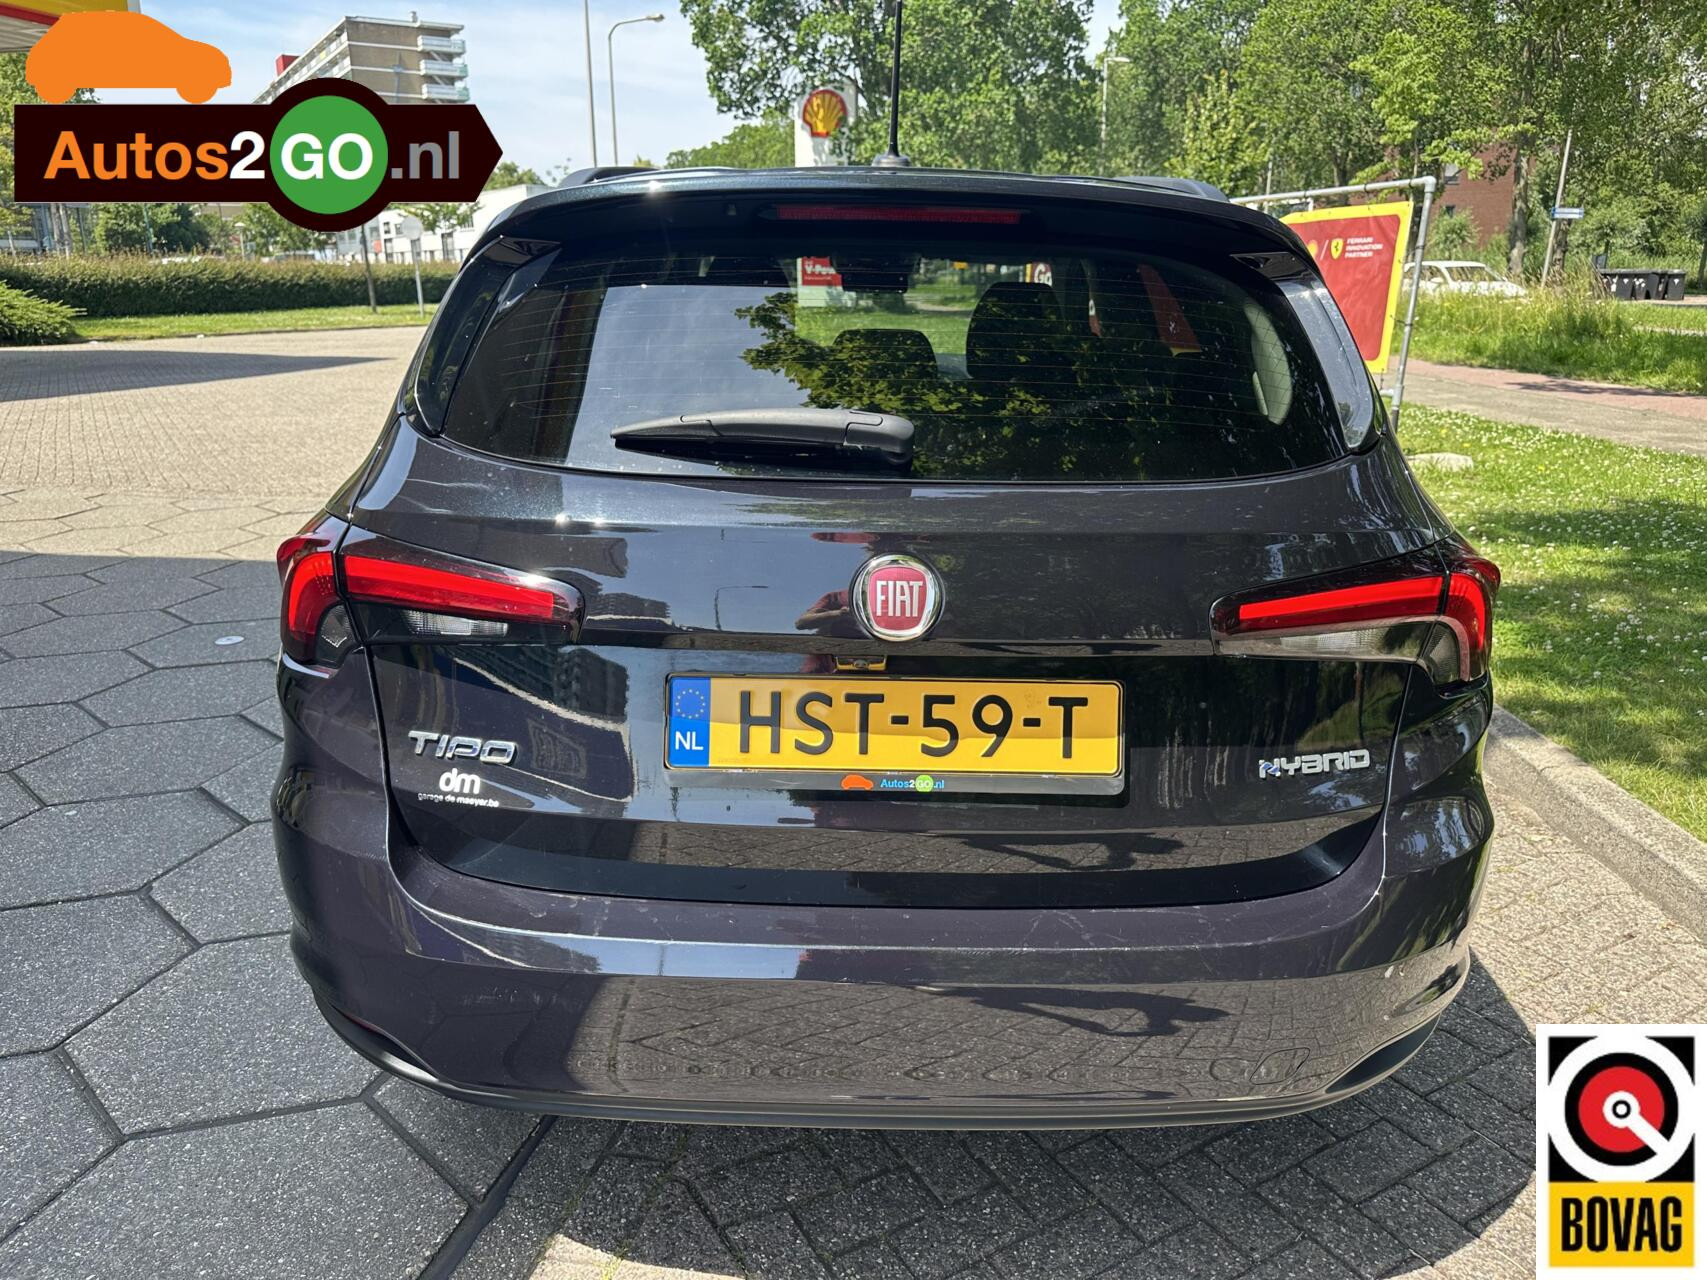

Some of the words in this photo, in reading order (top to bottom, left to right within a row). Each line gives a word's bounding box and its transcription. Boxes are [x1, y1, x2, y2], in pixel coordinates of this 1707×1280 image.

[1344, 251, 1374, 259] PARTNER
[1345, 243, 1384, 252] INNOVATION
[875, 580, 923, 617] FIAT
[739, 690, 1089, 759] HST-59-T
[408, 730, 518, 765] TIPO
[675, 731, 704, 750] NL
[1258, 748, 1371, 779] HYBRID
[438, 768, 481, 795] dm
[880, 778, 945, 790] Autos2GO.nl
[417, 793, 444, 803] garage
[444, 794, 456, 803] de
